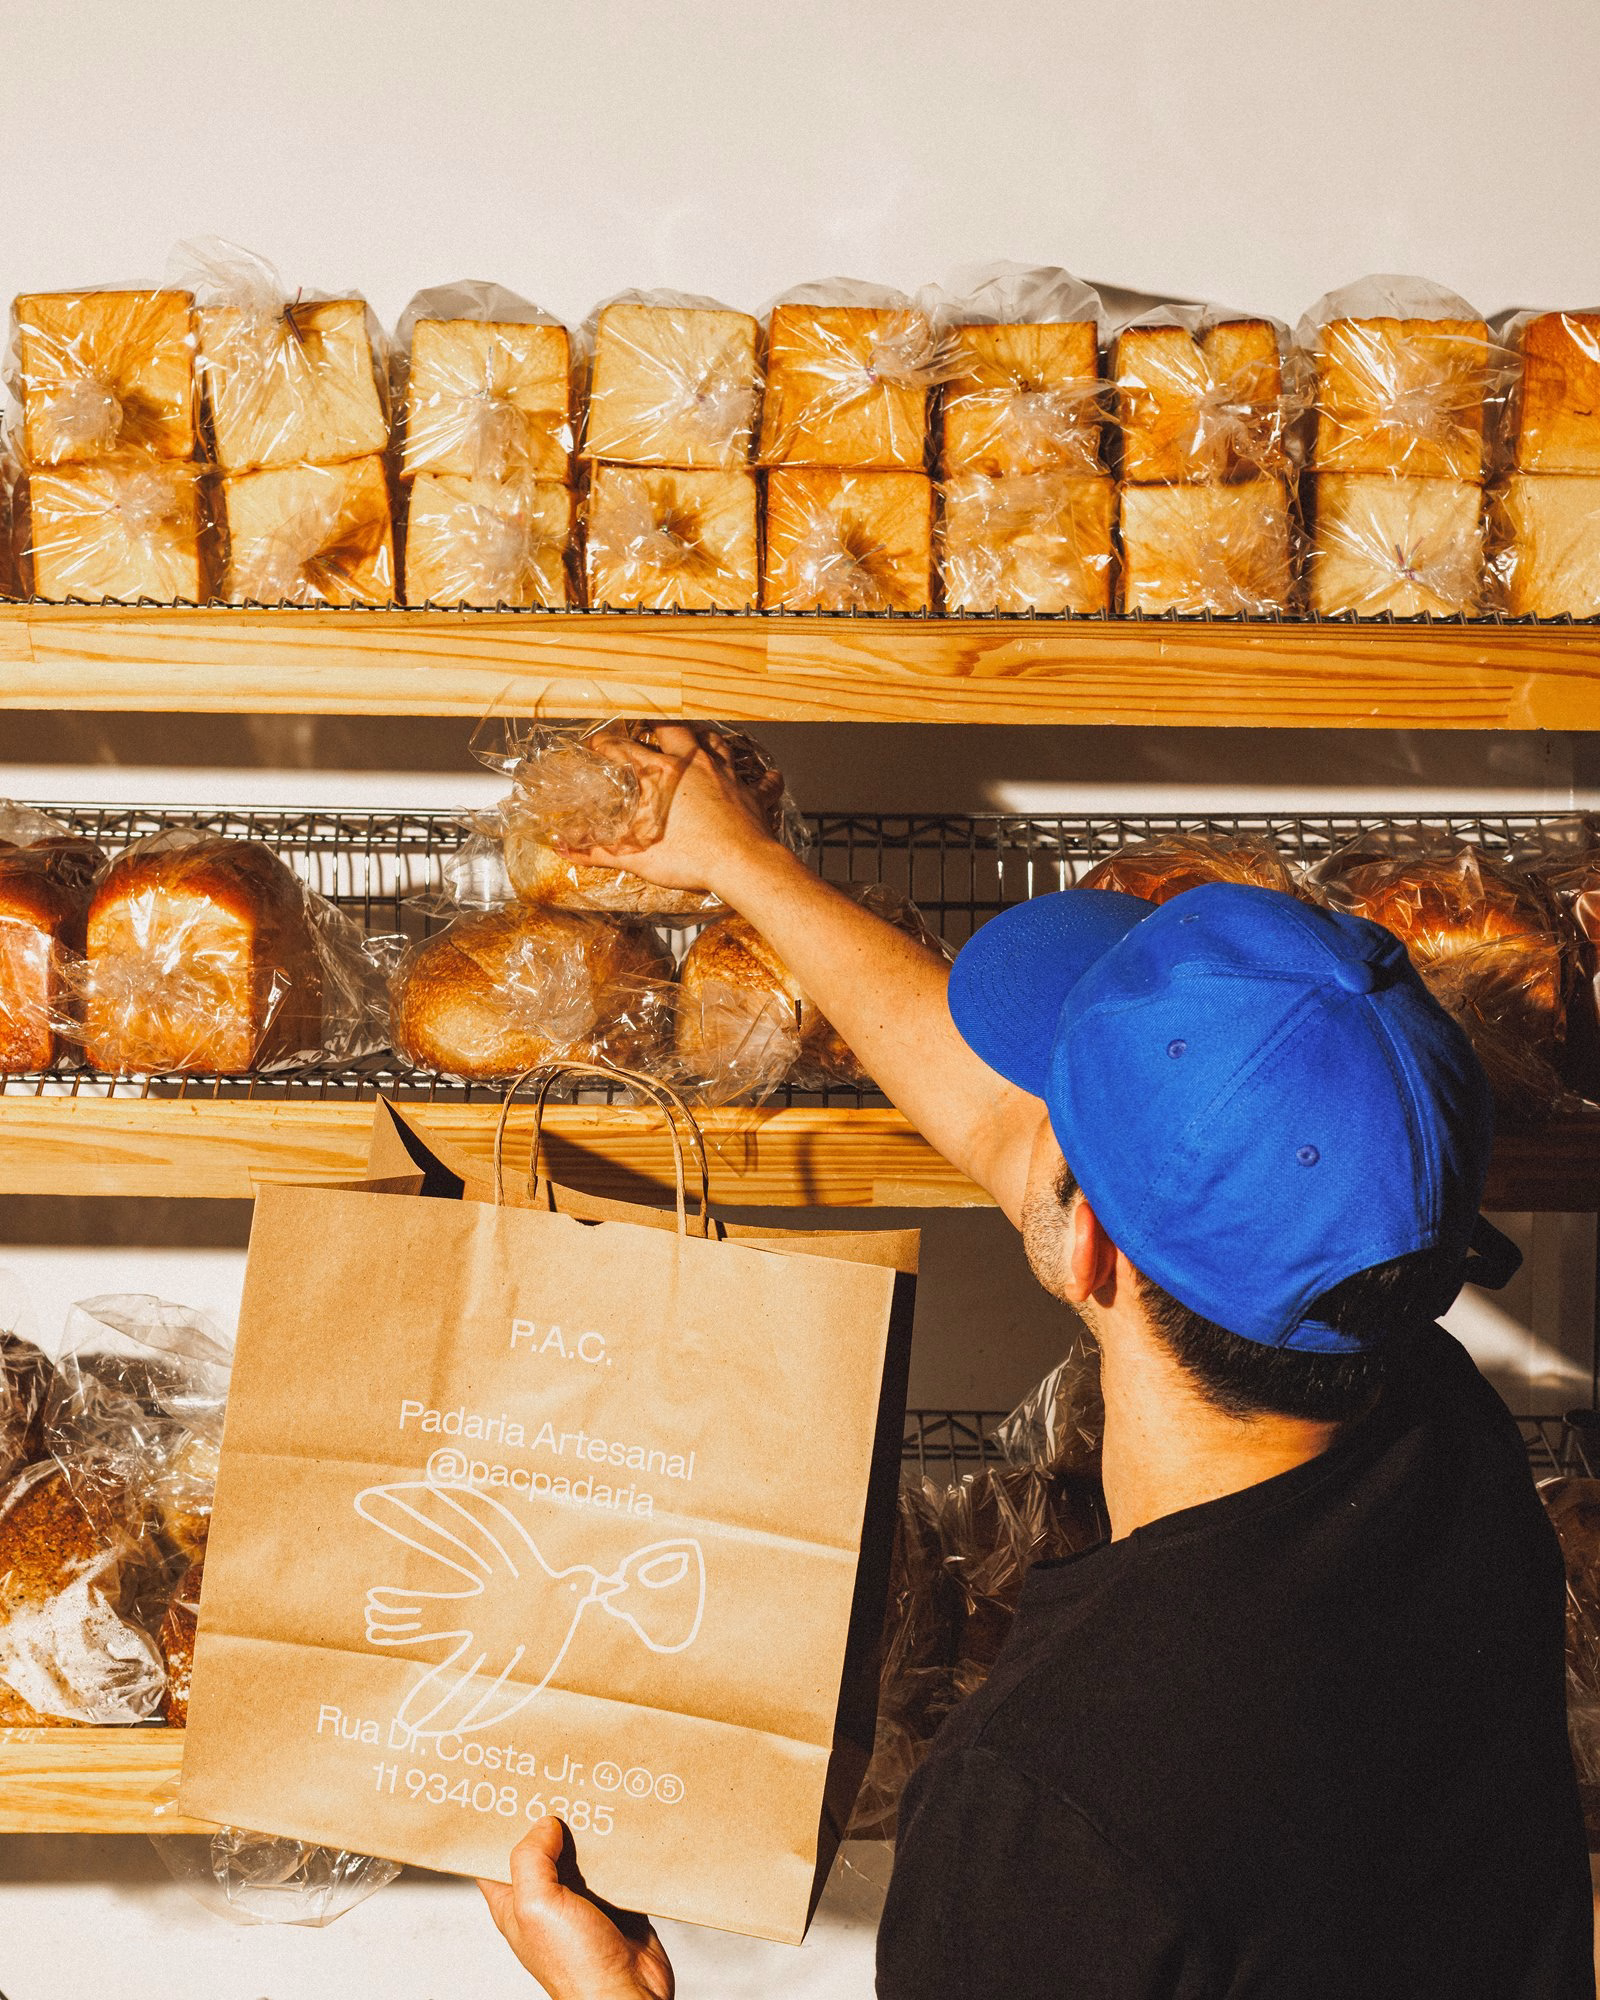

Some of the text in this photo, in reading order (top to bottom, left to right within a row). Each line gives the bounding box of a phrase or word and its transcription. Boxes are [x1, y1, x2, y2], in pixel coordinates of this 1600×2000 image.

[509, 1318, 613, 1366] P.A.C.
[399, 1399, 696, 1481] Padaria Artesanal
[427, 1447, 655, 1517] @pacpadaria
[316, 1704, 380, 1745] Rua
[388, 1718, 427, 1756] Dr.
[436, 1732, 537, 1777] Costa
[543, 1754, 585, 1786] Jr.
[372, 1761, 398, 1794] 11
[405, 1769, 519, 1817] 93408
